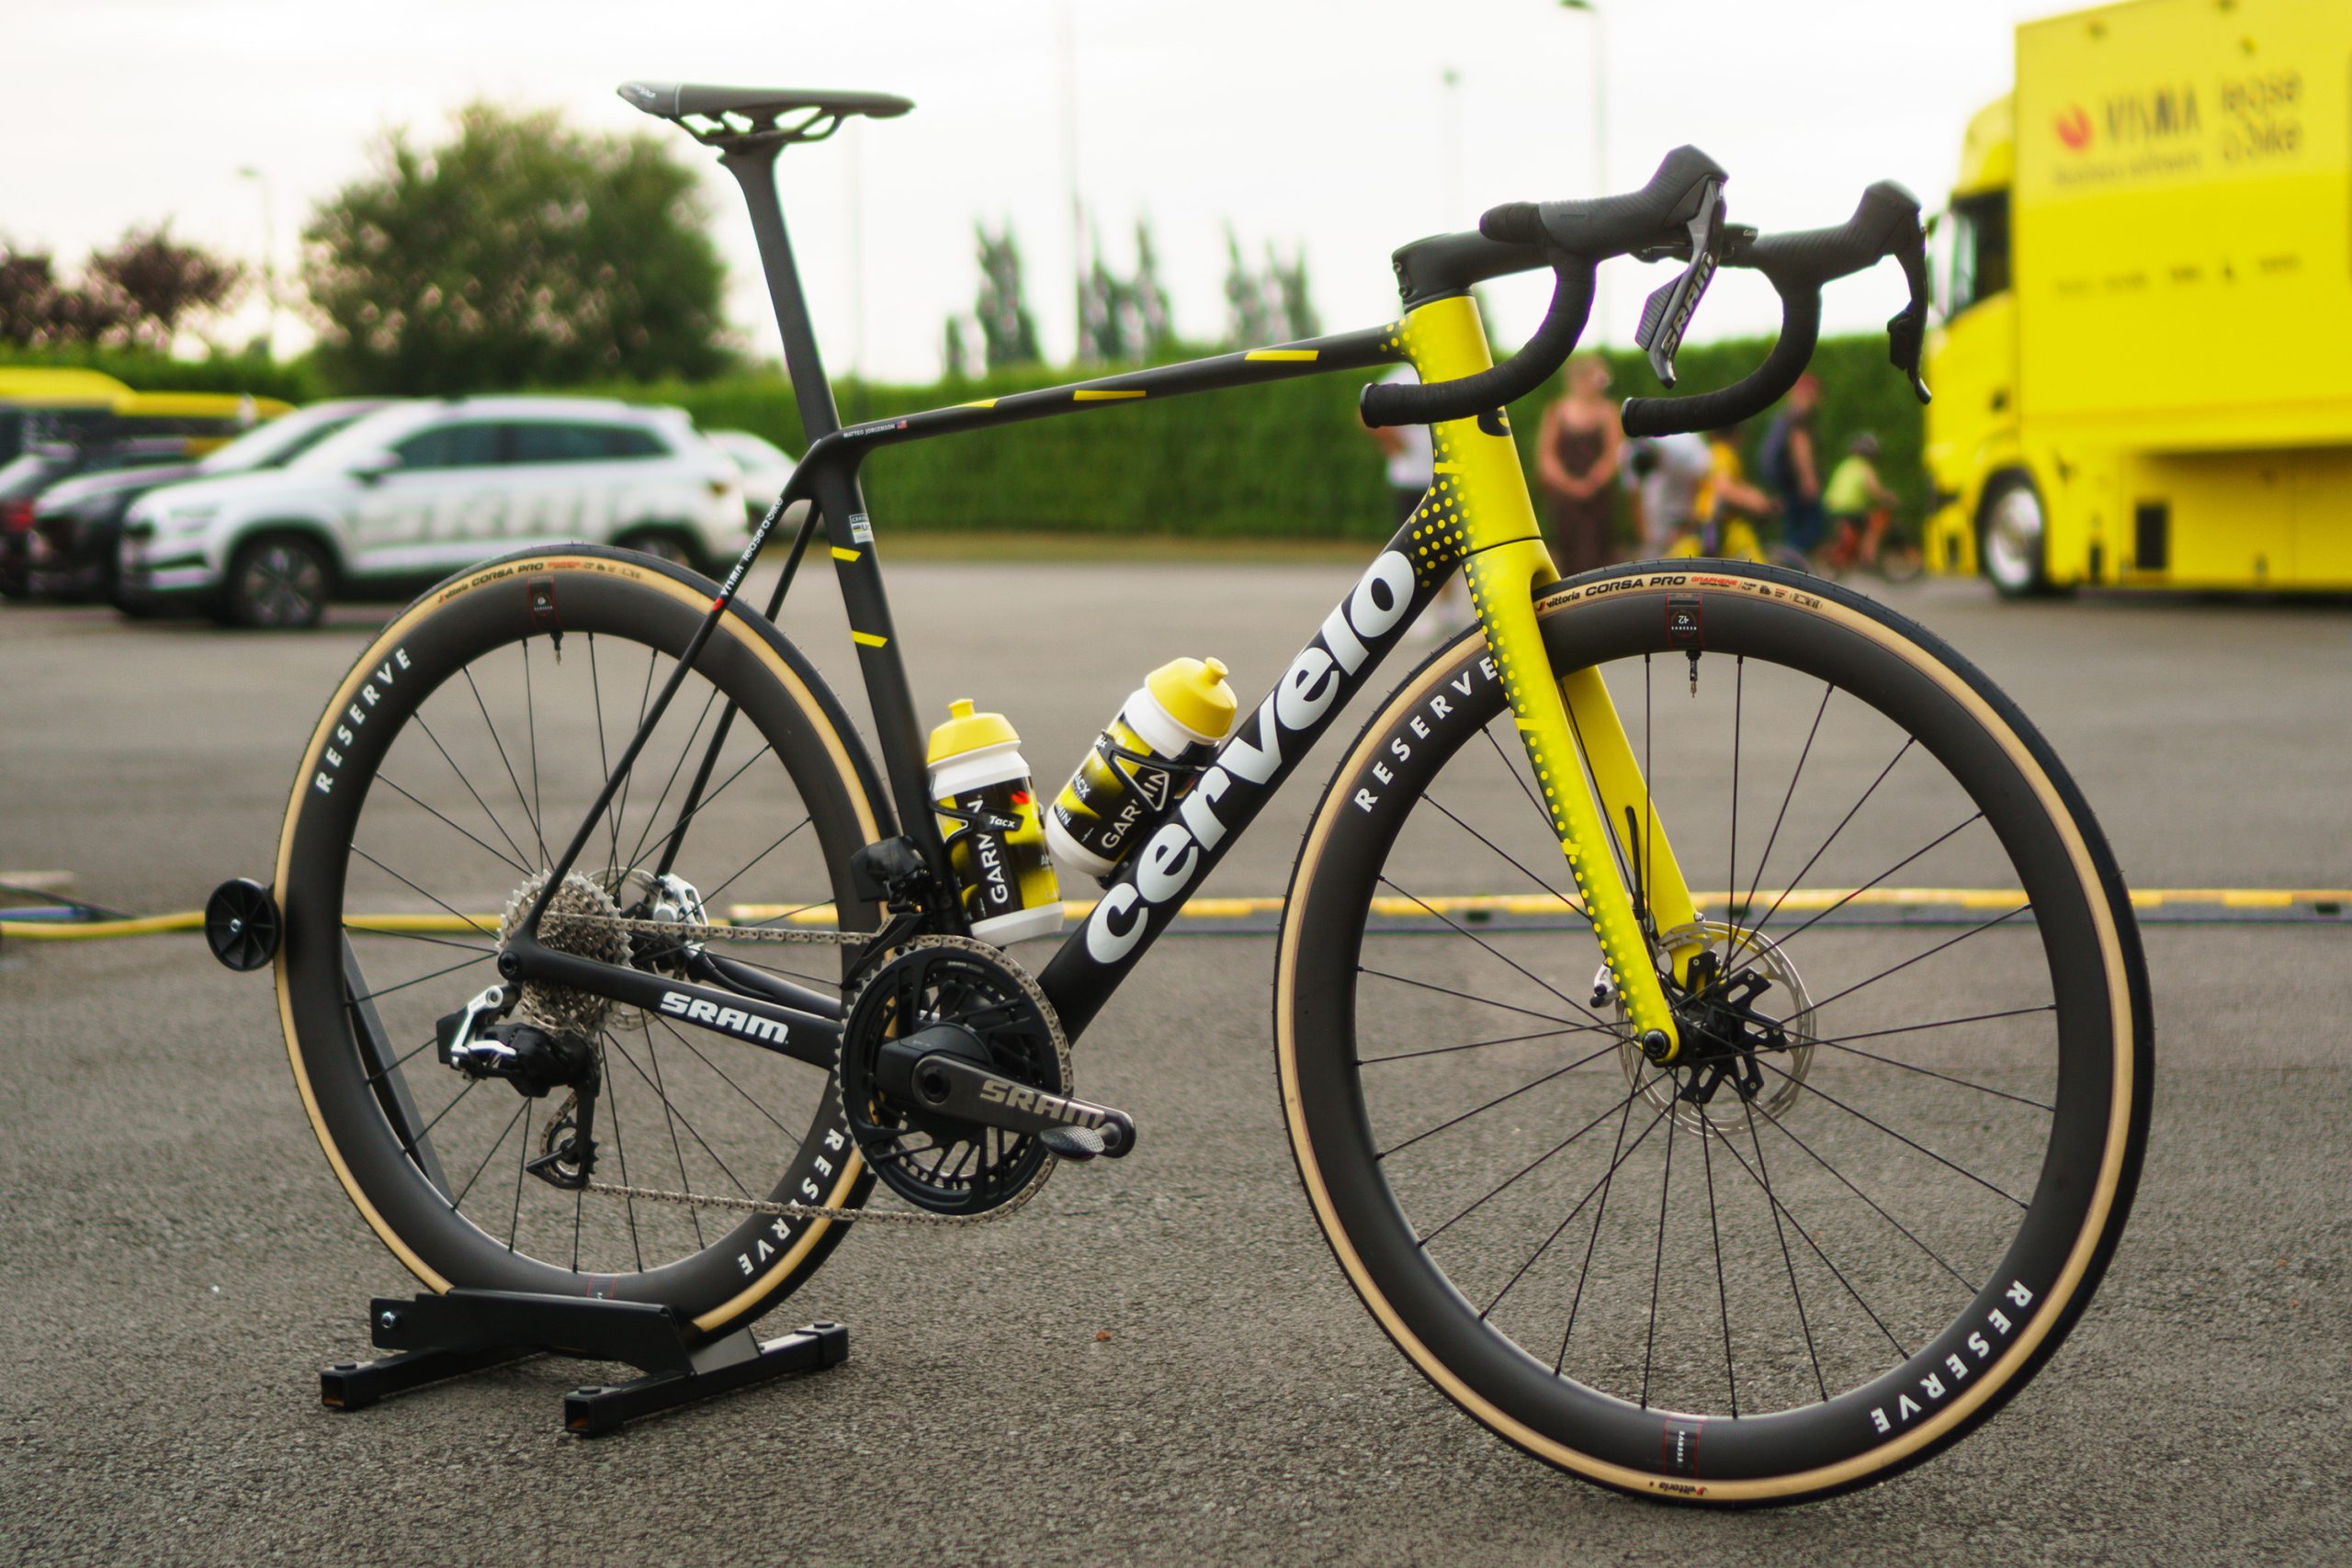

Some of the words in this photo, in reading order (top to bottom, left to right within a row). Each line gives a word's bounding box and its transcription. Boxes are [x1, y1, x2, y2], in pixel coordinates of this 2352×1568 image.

[1661, 252, 1714, 358] SRAM
[843, 429, 865, 438] MATTEO
[865, 423, 896, 435] JORGENSON
[471, 568, 514, 587] CORSA
[517, 562, 544, 573] PRO
[720, 564, 744, 596] VISMA
[742, 528, 765, 561] lease
[1547, 591, 1580, 608] vittoria
[1585, 577, 1644, 596] CORSA
[1649, 576, 1687, 587] PRO
[1690, 576, 1737, 585] GRAPHENE
[1678, 615, 1690, 625] 42
[315, 648, 412, 794] RESERVE
[1353, 656, 1498, 813] RESERVE
[989, 815, 1016, 829] Tacx
[967, 797, 1009, 905] GARMN
[660, 991, 789, 1044] SRAM
[979, 1079, 1105, 1130] SRAM
[1870, 1280, 2034, 1434] RESERVE
